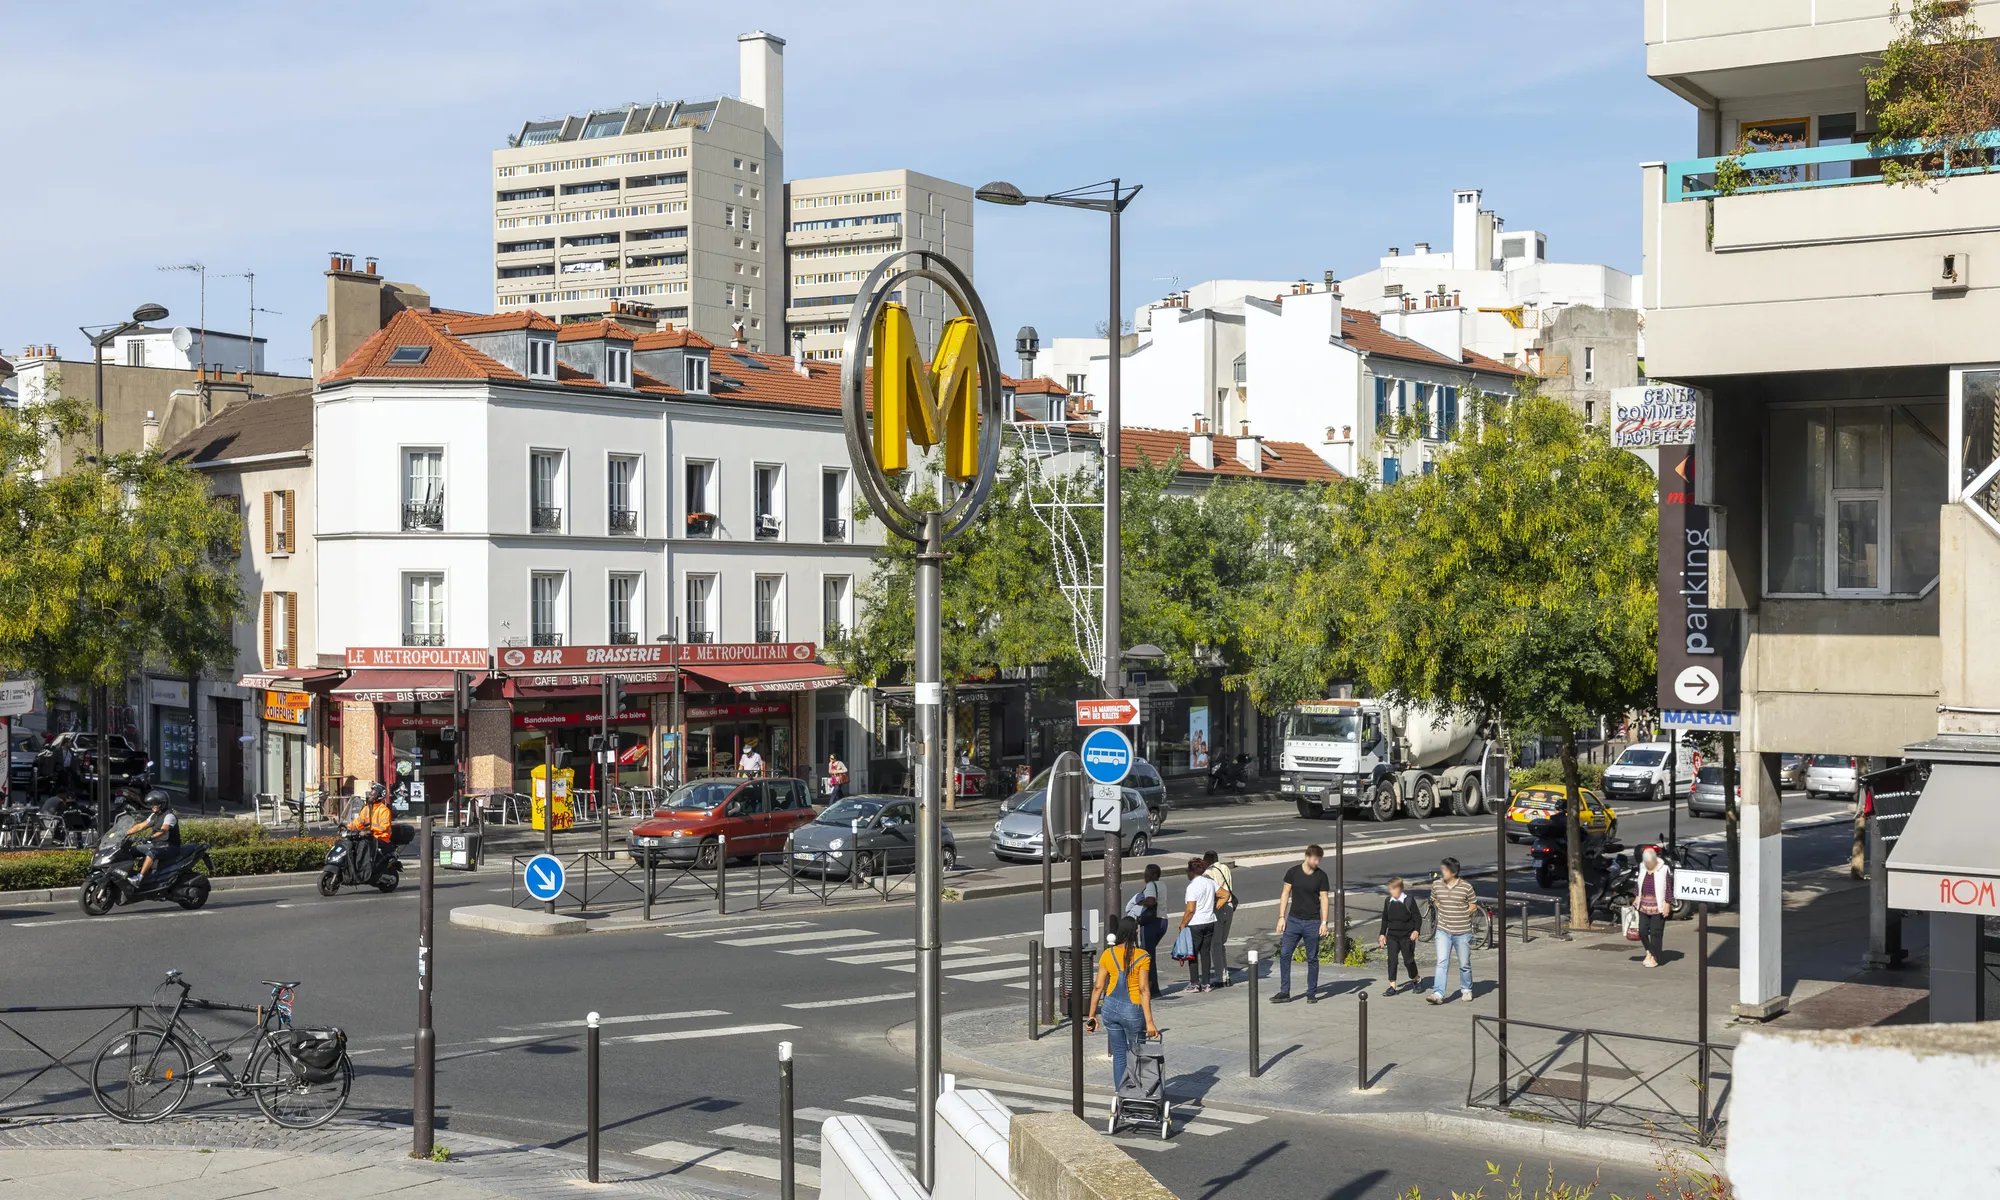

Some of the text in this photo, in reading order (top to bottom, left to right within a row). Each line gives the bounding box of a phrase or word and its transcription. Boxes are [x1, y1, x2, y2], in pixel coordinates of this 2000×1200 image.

[873, 302, 979, 482] M
[1679, 528, 1715, 655] parking
[347, 649, 487, 665] LE METROPOLITAIN
[532, 646, 661, 665] BAR BRASSERIE
[697, 645, 788, 661] METROPOLITAIN
[534, 673, 658, 686] CAFE BAR NDWICHES
[761, 682, 806, 692] LIMONADIER
[812, 679, 838, 689] SALON
[354, 691, 445, 702] CAFE BISTROT
[265, 705, 295, 721] COIFFURE
[524, 715, 566, 724] Sandwiches
[1664, 709, 1737, 725] MARAT
[402, 718, 424, 726] Café
[432, 718, 449, 726] Bar
[1694, 876, 1709, 884] RUE
[1681, 885, 1721, 897] MARAT
